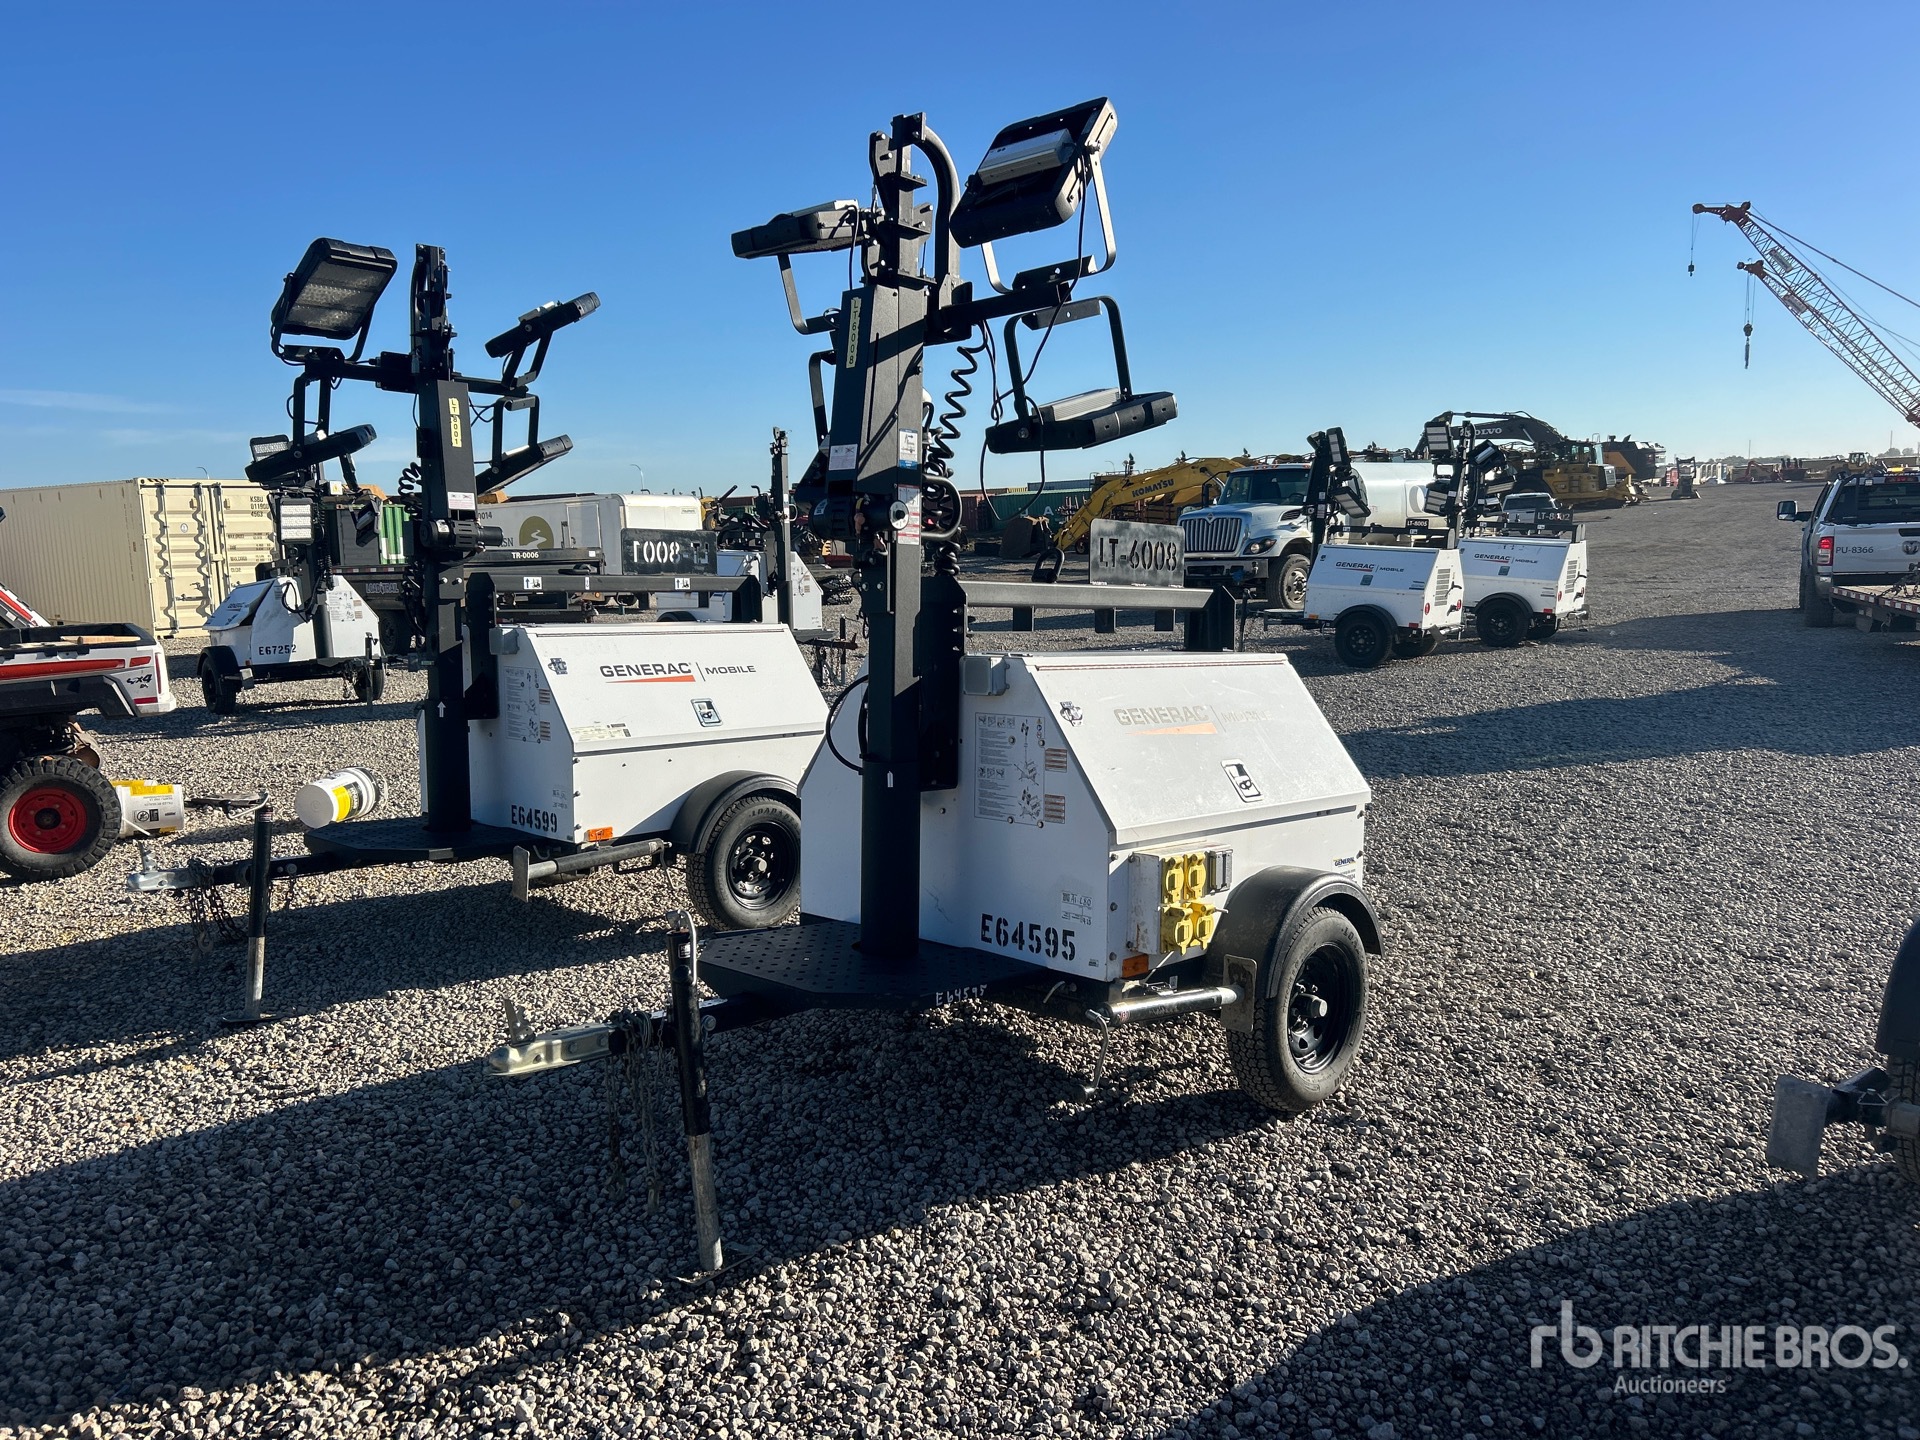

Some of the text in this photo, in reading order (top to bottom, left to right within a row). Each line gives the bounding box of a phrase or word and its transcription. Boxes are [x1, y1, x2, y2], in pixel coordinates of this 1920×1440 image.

[1131, 478, 1175, 498] KOMATSU
[511, 551, 540, 560] TR-0006
[1099, 537, 1178, 572] LT-6008
[1473, 553, 1511, 561] GENERAC
[1835, 546, 1874, 554] PU-8366
[1335, 561, 1376, 570] GENERAC
[258, 644, 297, 656] E67252
[600, 661, 757, 678] GENERAC MOBILE
[1113, 705, 1210, 726] GENERAC
[511, 804, 558, 833] E64599
[981, 913, 1076, 961] E64595
